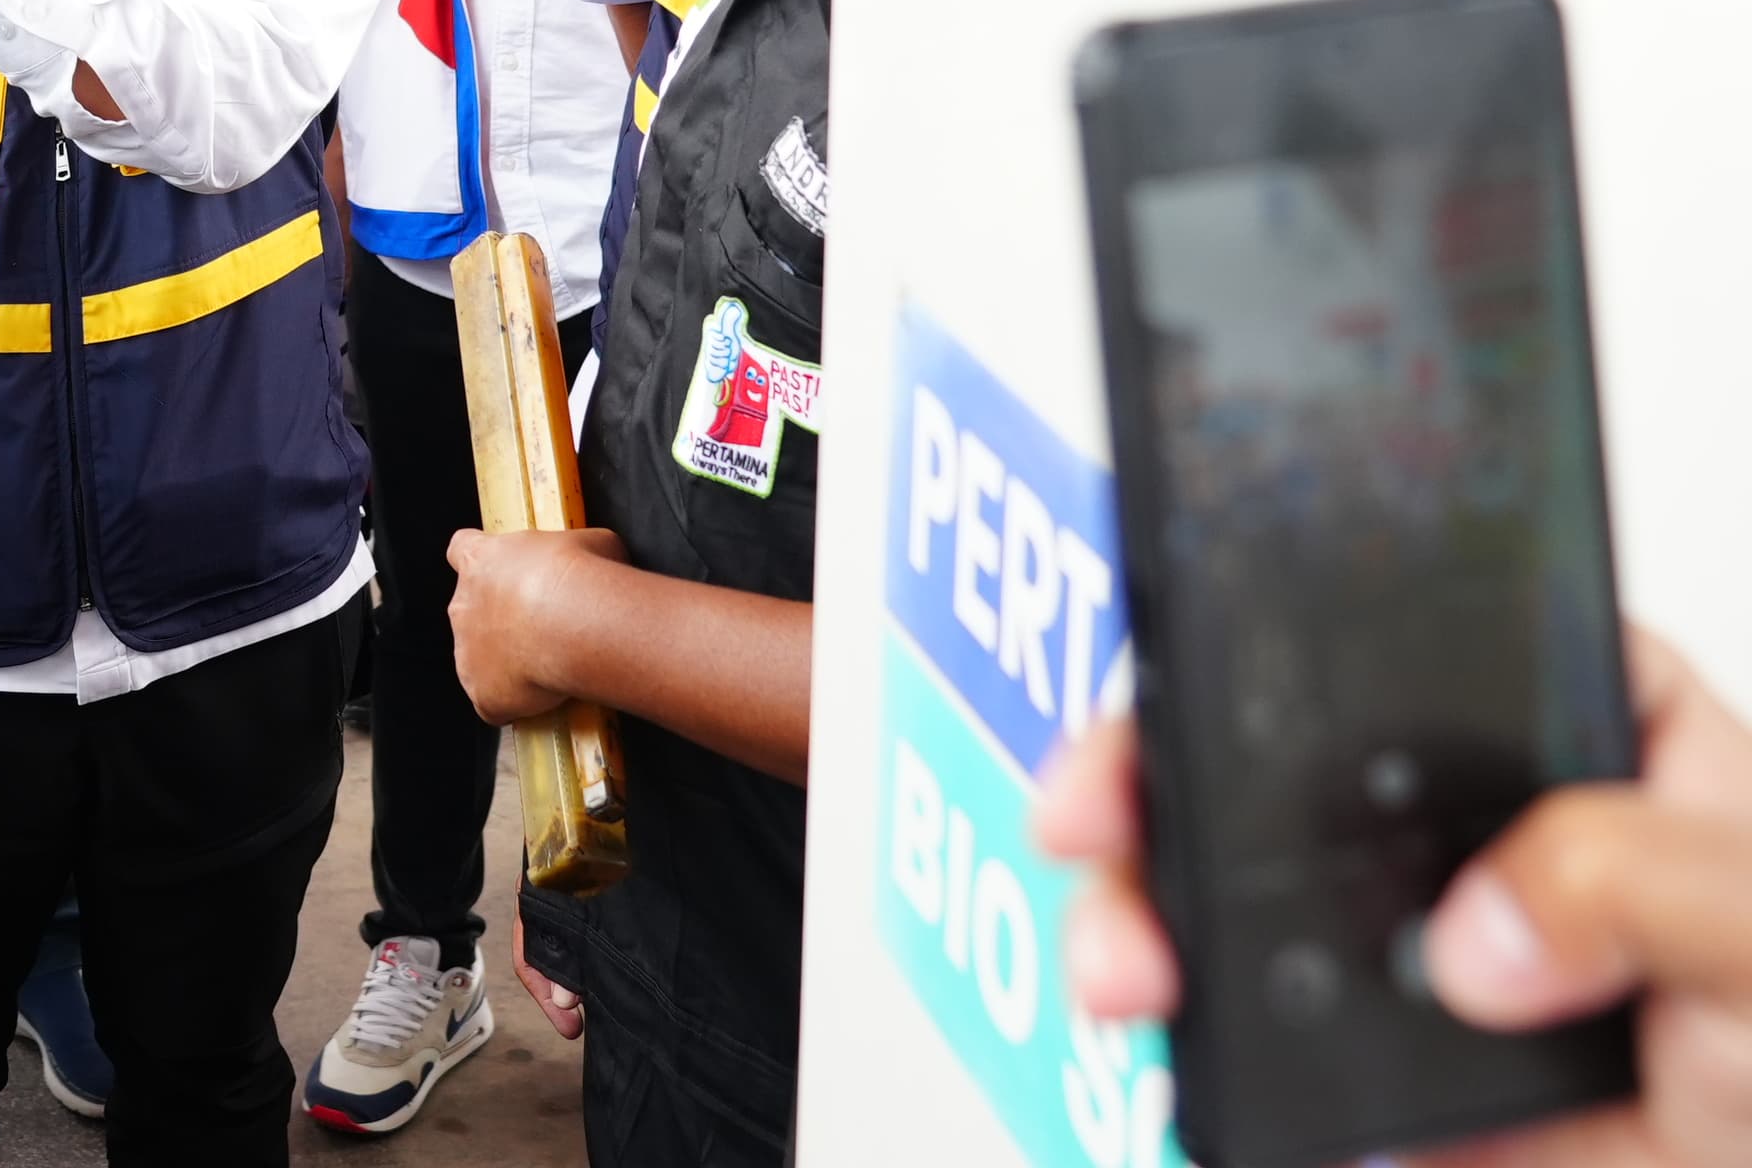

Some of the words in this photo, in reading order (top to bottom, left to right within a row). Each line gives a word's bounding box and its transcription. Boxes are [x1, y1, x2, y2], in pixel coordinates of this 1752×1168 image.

[770, 360, 821, 398] PASTI
[771, 385, 811, 418] PAS!
[689, 458, 728, 477] Always
[728, 467, 758, 488] There
[694, 437, 769, 479] PERTAMINA
[890, 737, 1040, 1046] BIO
